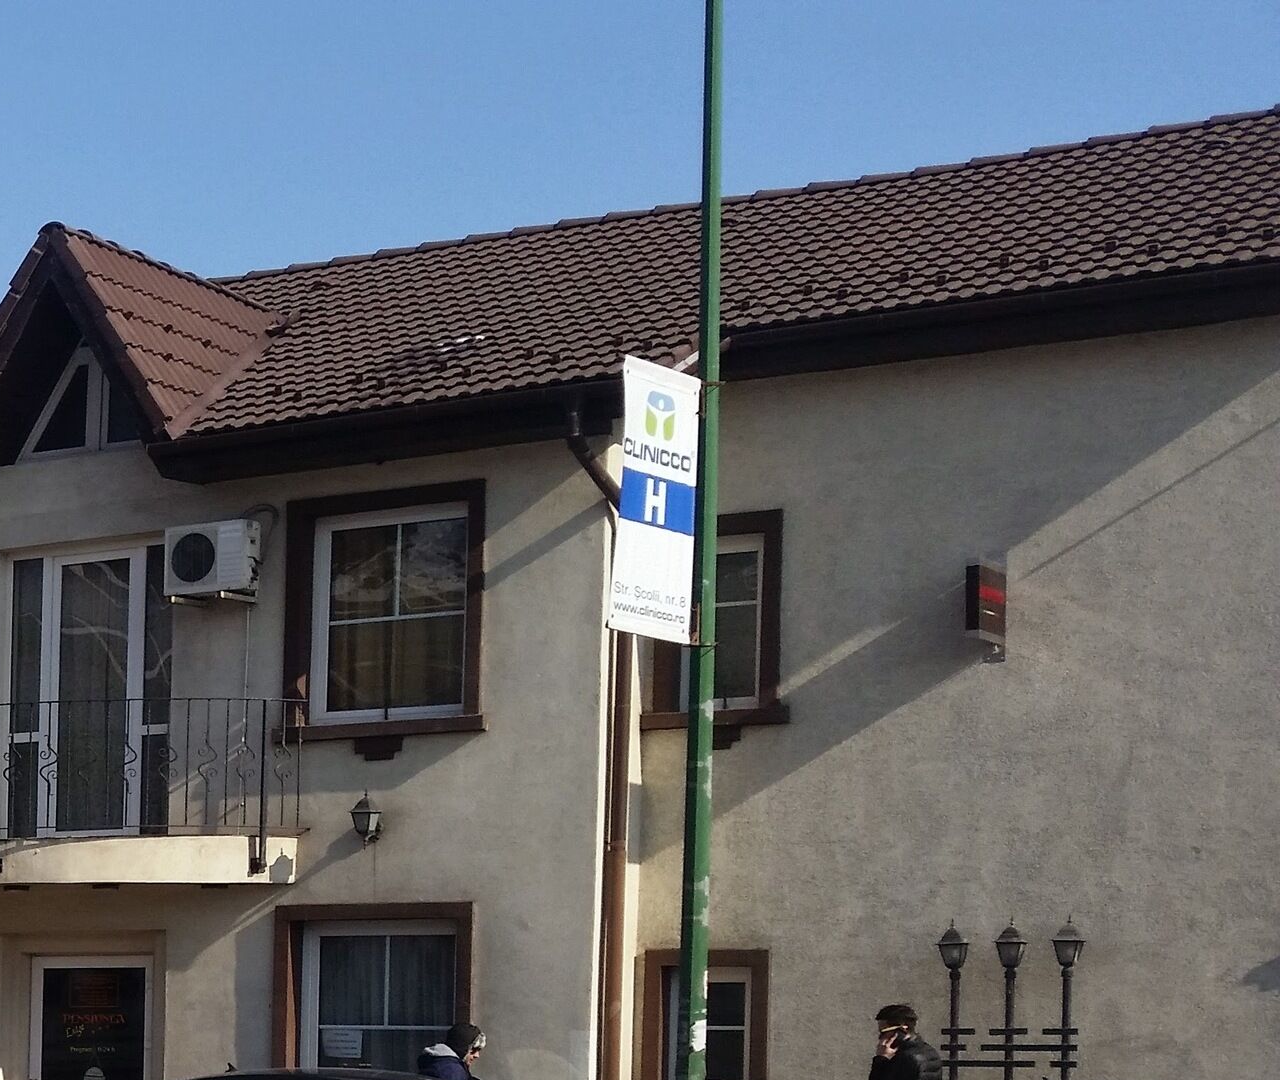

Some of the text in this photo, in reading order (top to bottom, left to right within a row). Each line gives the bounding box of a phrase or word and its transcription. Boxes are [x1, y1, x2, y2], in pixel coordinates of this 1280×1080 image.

[623, 437, 692, 473] CLINICCO
[644, 477, 667, 526] H
[614, 581, 631, 596] Str.
[679, 596, 686, 608] 8
[613, 601, 686, 624] www.clinicco.ro
